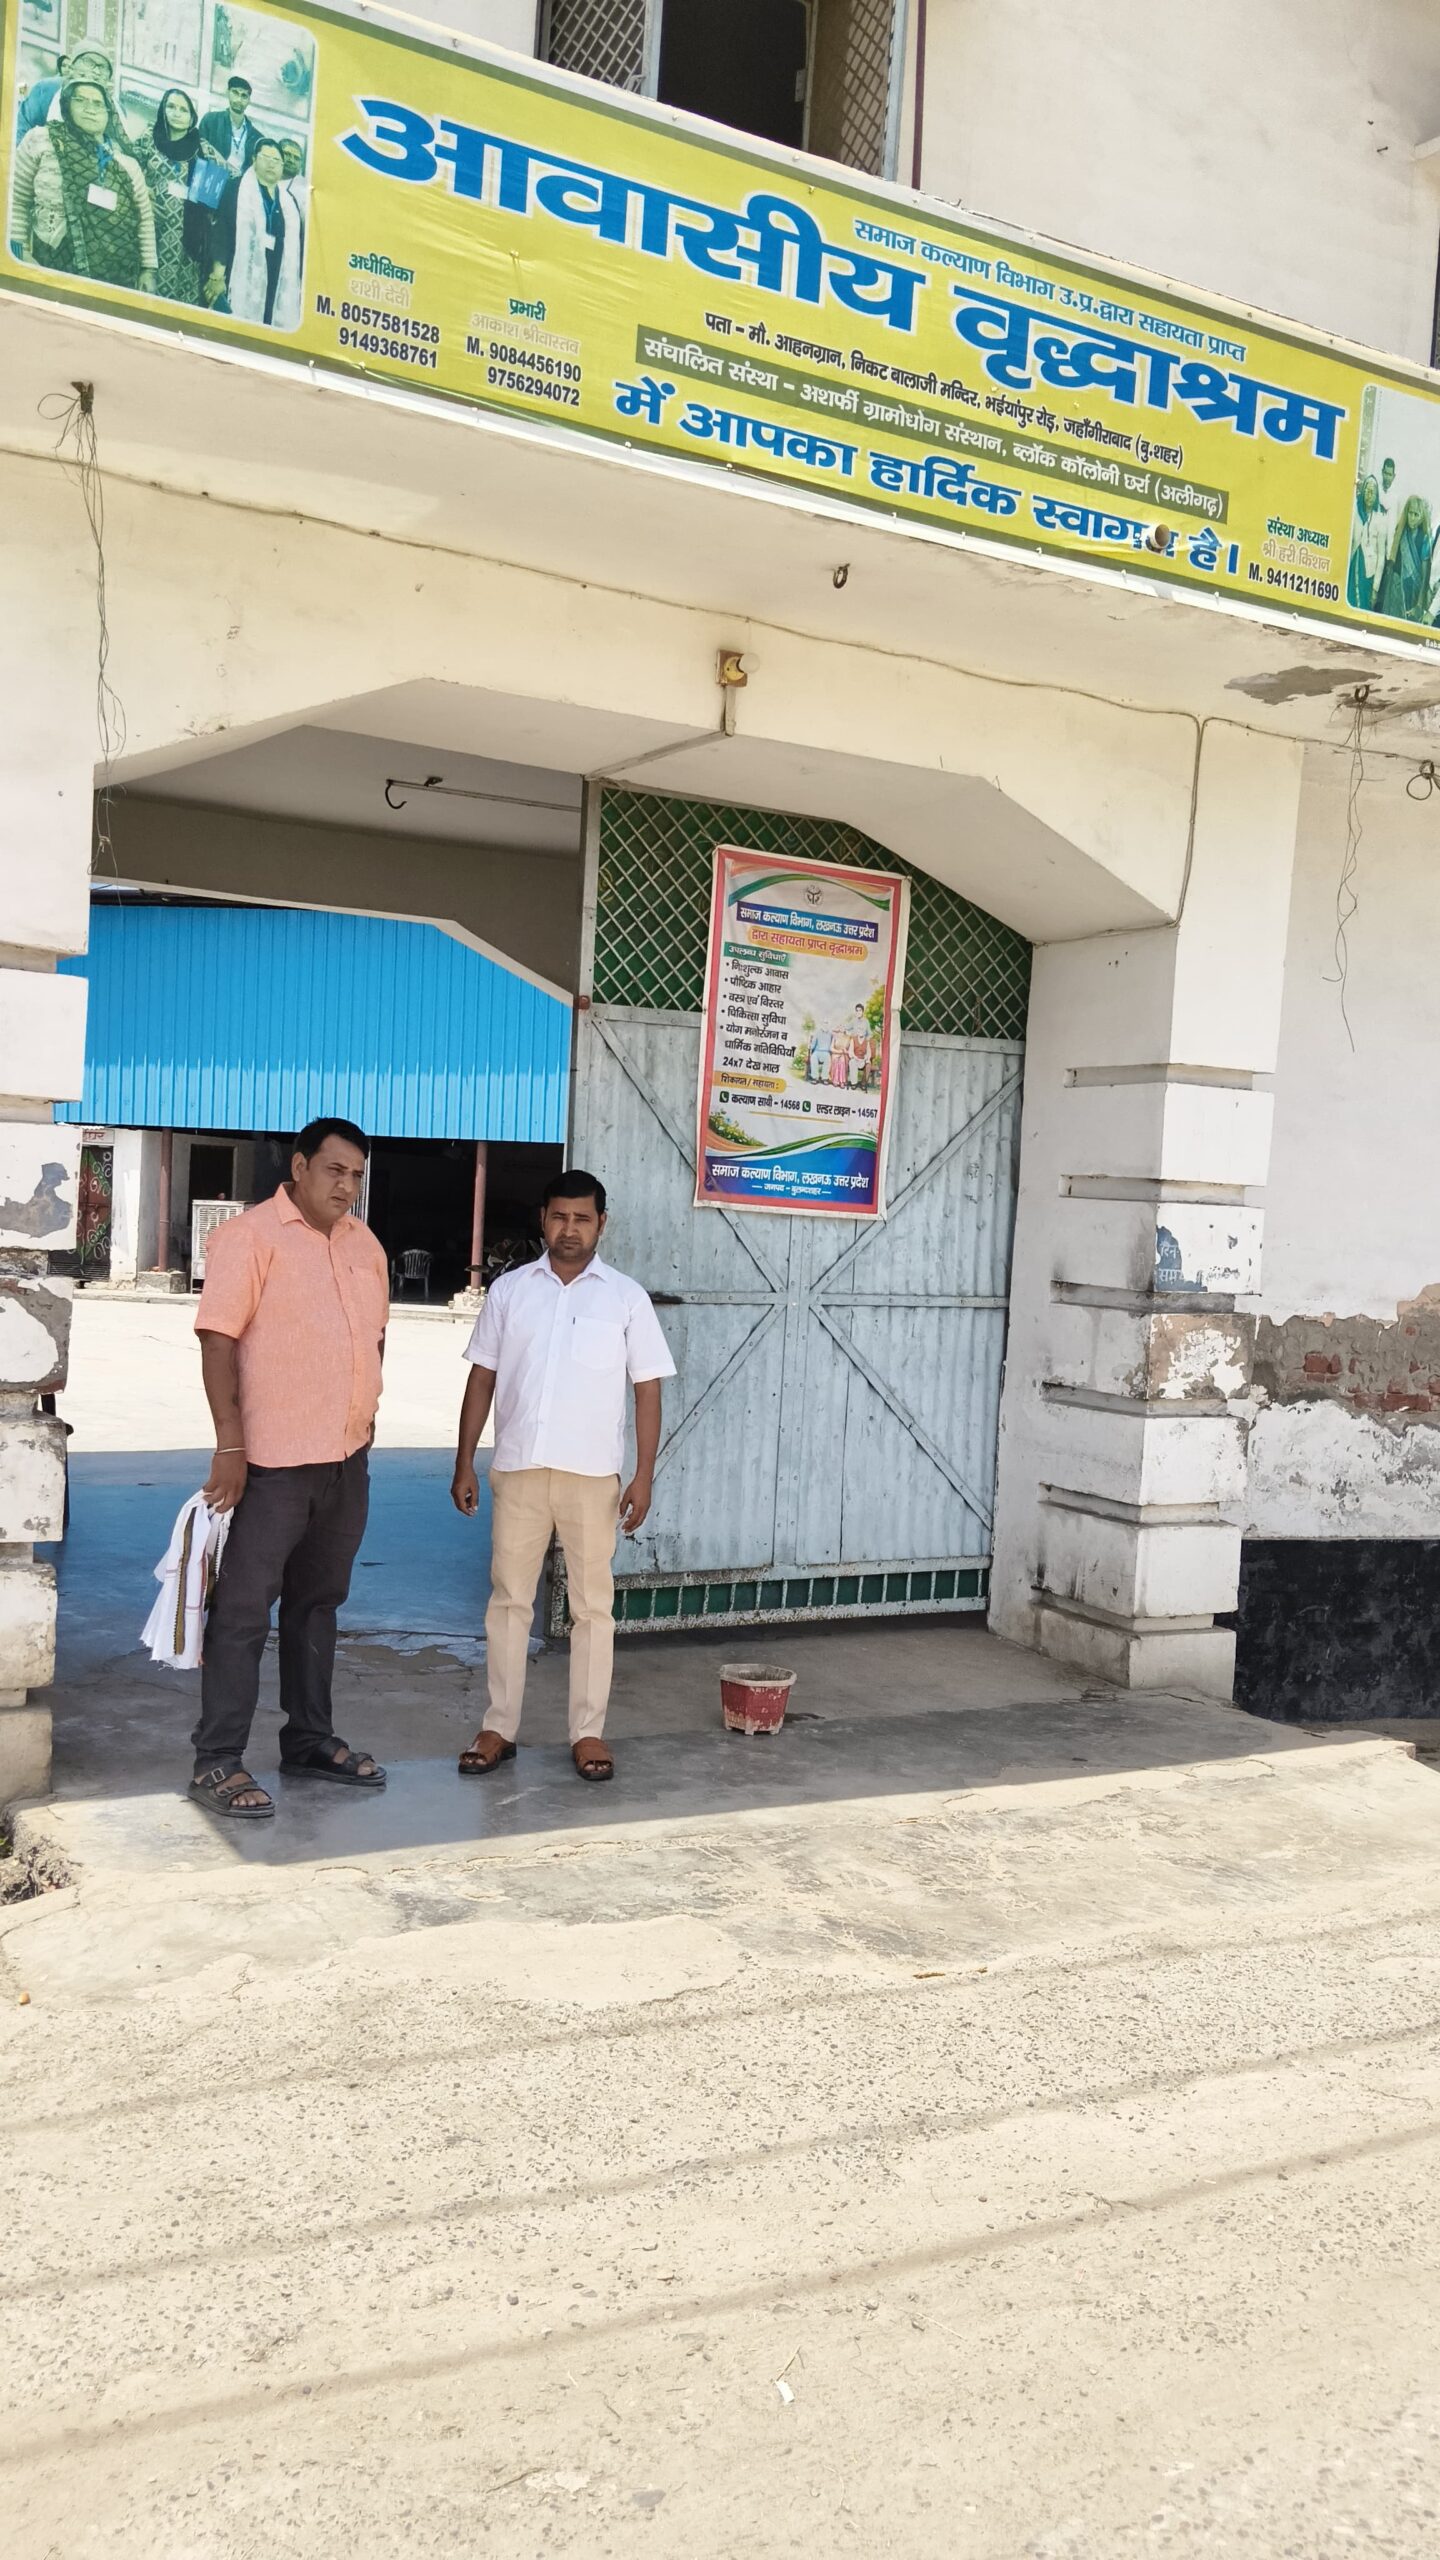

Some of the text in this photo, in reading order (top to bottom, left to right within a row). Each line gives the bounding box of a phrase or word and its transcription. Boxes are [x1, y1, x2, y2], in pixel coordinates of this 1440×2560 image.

[341, 99, 926, 330] आवासीय
[349, 253, 415, 284] अधीक्षिका
[855, 219, 917, 255] समाज
[921, 241, 991, 279] कल्याण
[996, 261, 1055, 299] विभाग
[1139, 312, 1204, 348] सहायता
[1208, 336, 1247, 362] प्राप्त
[316, 296, 440, 344] M. 8057581528
[509, 298, 546, 321] प्रभारी
[339, 327, 437, 368] 9149368761
[466, 336, 581, 382] M. 9084456190
[488, 367, 580, 406] 9756294072
[705, 313, 731, 336] पता
[749, 321, 770, 347] मौ.
[851, 350, 888, 380] निकट
[891, 367, 937, 395] बालाजी
[1064, 416, 1133, 451] जहाँगीराबाद
[644, 337, 724, 376] संचालित
[728, 360, 778, 392] संस्था
[800, 383, 860, 414] अशर्फी
[944, 422, 1006, 457] संस्थान,
[1012, 442, 1057, 468] ब्लॉक
[1061, 455, 1120, 486] कॉलोनी
[1124, 473, 1150, 494] छर्रा
[1155, 477, 1224, 519] (अलीगढ़)
[615, 376, 676, 424] में
[679, 403, 858, 475] आपका
[869, 451, 1022, 515] हार्दिक
[1267, 516, 1330, 549] संस्था अध्यक्ष
[1262, 540, 1276, 559] श्री
[1298, 547, 1331, 572] किशन
[1248, 562, 1340, 602] M. 9411211690
[740, 907, 761, 921] समाज
[763, 911, 789, 925] कल्याण
[816, 919, 842, 933] लखनऊ
[843, 923, 857, 936] उत्तर
[858, 923, 875, 939] प्रदेश
[752, 928, 863, 956] द्वारा सहायता प्राप्त वृद्धाश्रम
[758, 982, 782, 993] आहार
[765, 967, 789, 979] आवास
[729, 992, 745, 1003] वस्त्र
[746, 995, 760, 1005] एवं
[726, 1022, 743, 1035] योग
[744, 1026, 779, 1040] मनोरंजन
[761, 1011, 787, 1027] सुविधा
[725, 1038, 752, 1052] धार्मिक
[723, 1056, 780, 1073] 24x7 देख भाल
[731, 1093, 756, 1106] कल्याण
[780, 1099, 800, 1111] 14568
[857, 1109, 878, 1119] 14567
[712, 1164, 739, 1178] समाज
[741, 1167, 771, 1181] कल्याण
[802, 1172, 832, 1186] लखनऊ
[833, 1174, 849, 1187] उत्तर
[850, 1172, 869, 1190] प्रदेश
